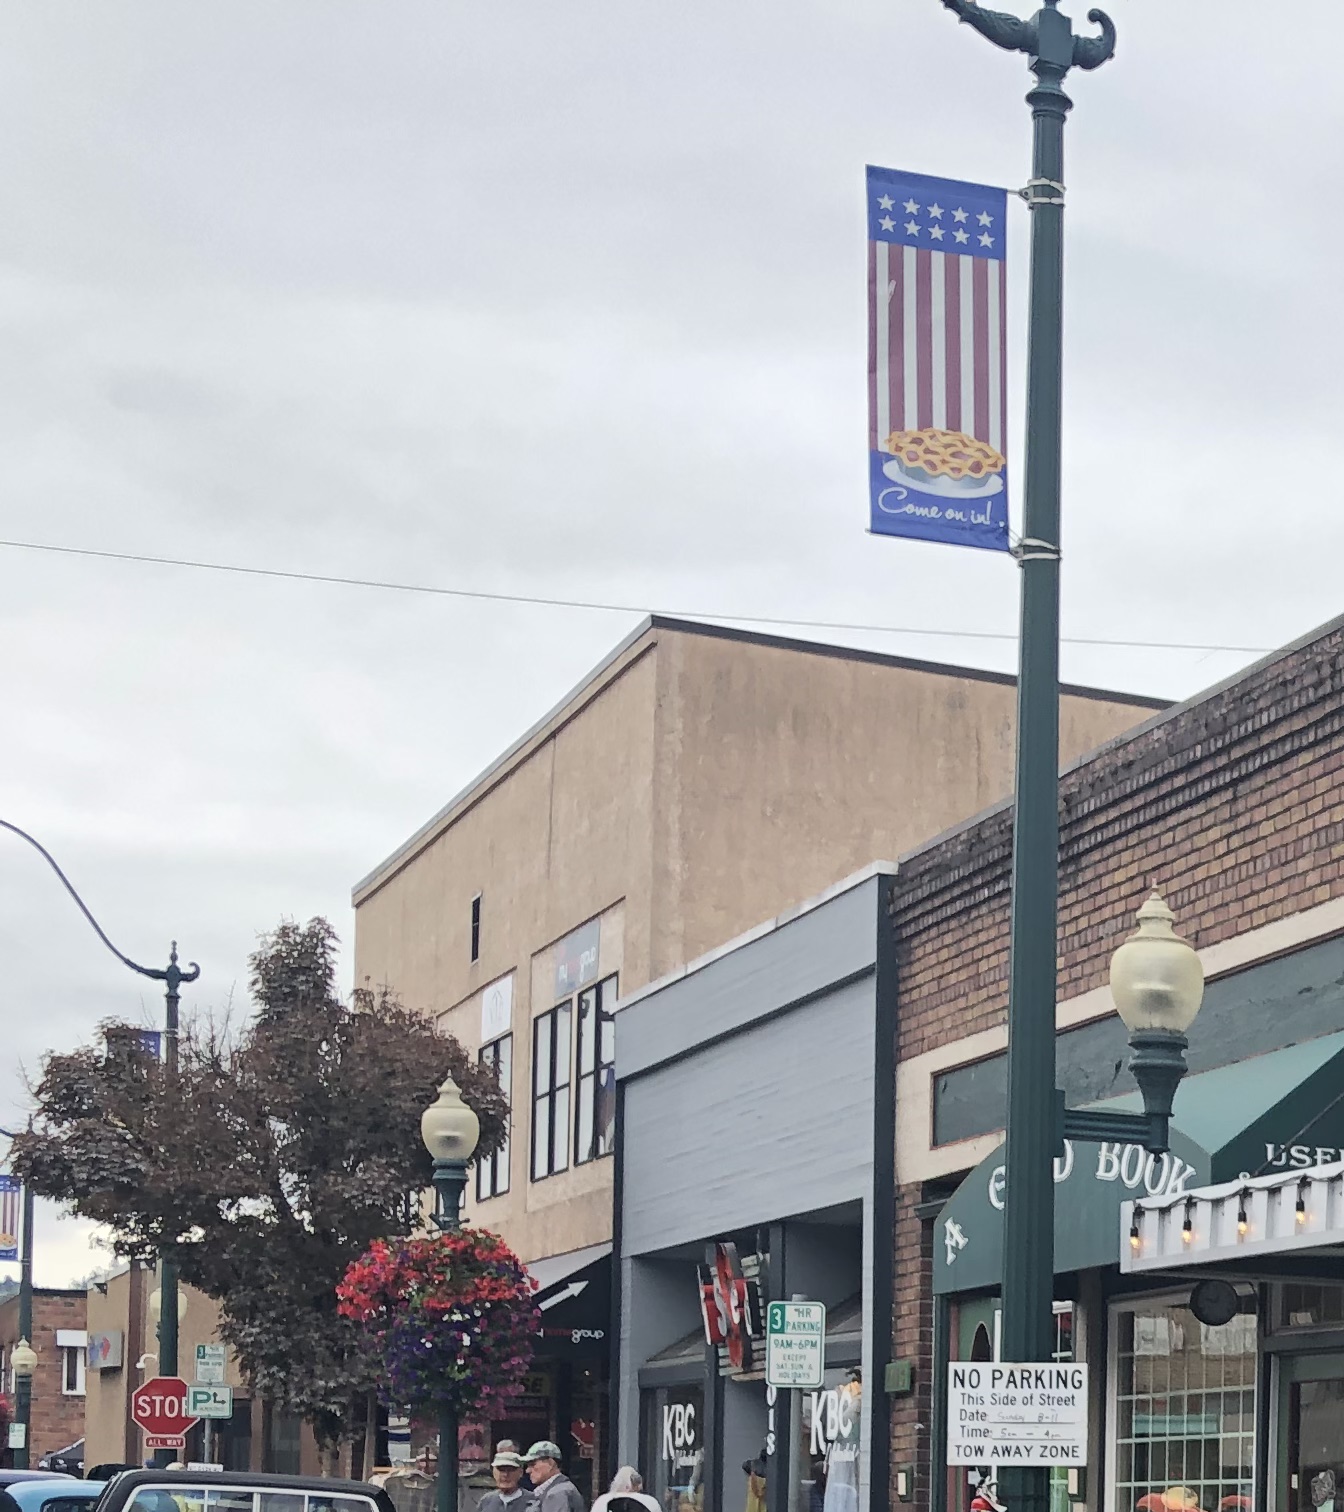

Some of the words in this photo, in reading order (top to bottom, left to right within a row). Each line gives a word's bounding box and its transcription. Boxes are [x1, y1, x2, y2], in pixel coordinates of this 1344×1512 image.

[878, 486, 942, 518] Come
[945, 508, 967, 522] on
[944, 1216, 969, 1266] A
[1095, 1141, 1197, 1197] BOOK
[771, 1308, 782, 1330] 3
[786, 1321, 821, 1332] PARKING
[773, 1339, 818, 1350] 9AM-6PM
[953, 1369, 981, 1389] NO
[992, 1369, 1083, 1390] PARKING
[960, 1392, 985, 1406] This
[990, 1392, 1017, 1406] Side
[1022, 1393, 1034, 1406] of
[1039, 1393, 1076, 1406] Street
[662, 1403, 695, 1461] KBC
[809, 1389, 852, 1455] KBC
[148, 1438, 162, 1447] ALL
[166, 1438, 183, 1447] WAY
[954, 1445, 984, 1458] TOW
[990, 1445, 1034, 1458] AWAY
[1040, 1445, 1079, 1458] ZONE
